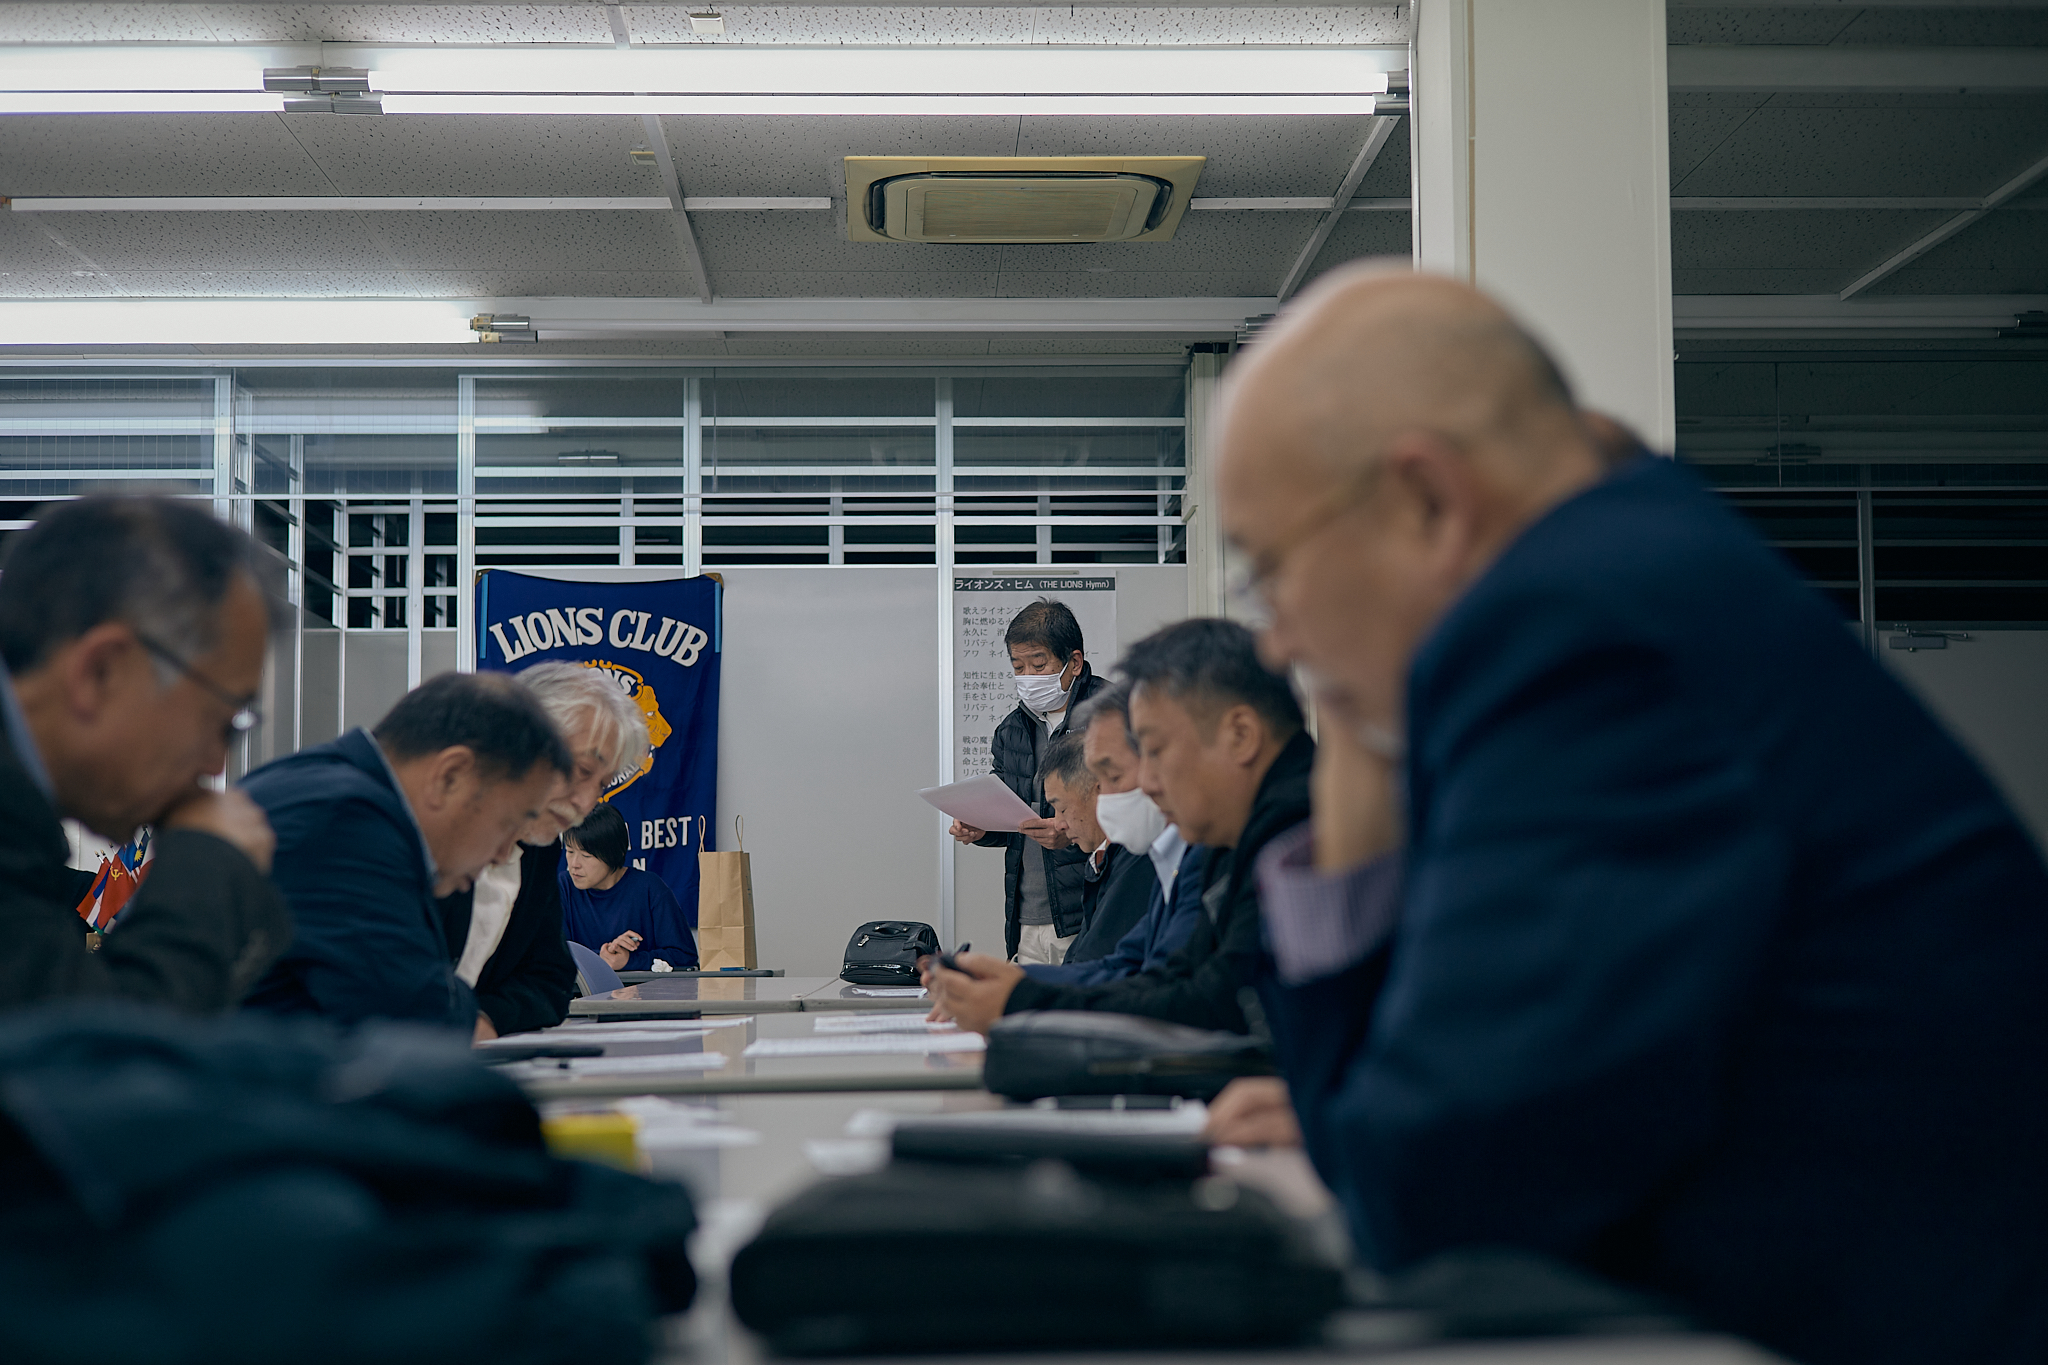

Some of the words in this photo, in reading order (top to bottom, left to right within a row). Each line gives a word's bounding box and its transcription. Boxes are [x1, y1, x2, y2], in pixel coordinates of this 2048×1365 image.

[955, 579, 1034, 590] ライオンズ・ヒム
[1060, 580, 1084, 589] LIONS
[489, 607, 603, 664] LIONS
[608, 609, 708, 667] CLUB
[963, 671, 1014, 680] 知性に生きる
[963, 681, 1005, 690] 社会奉仕と
[641, 815, 692, 850] BEST
